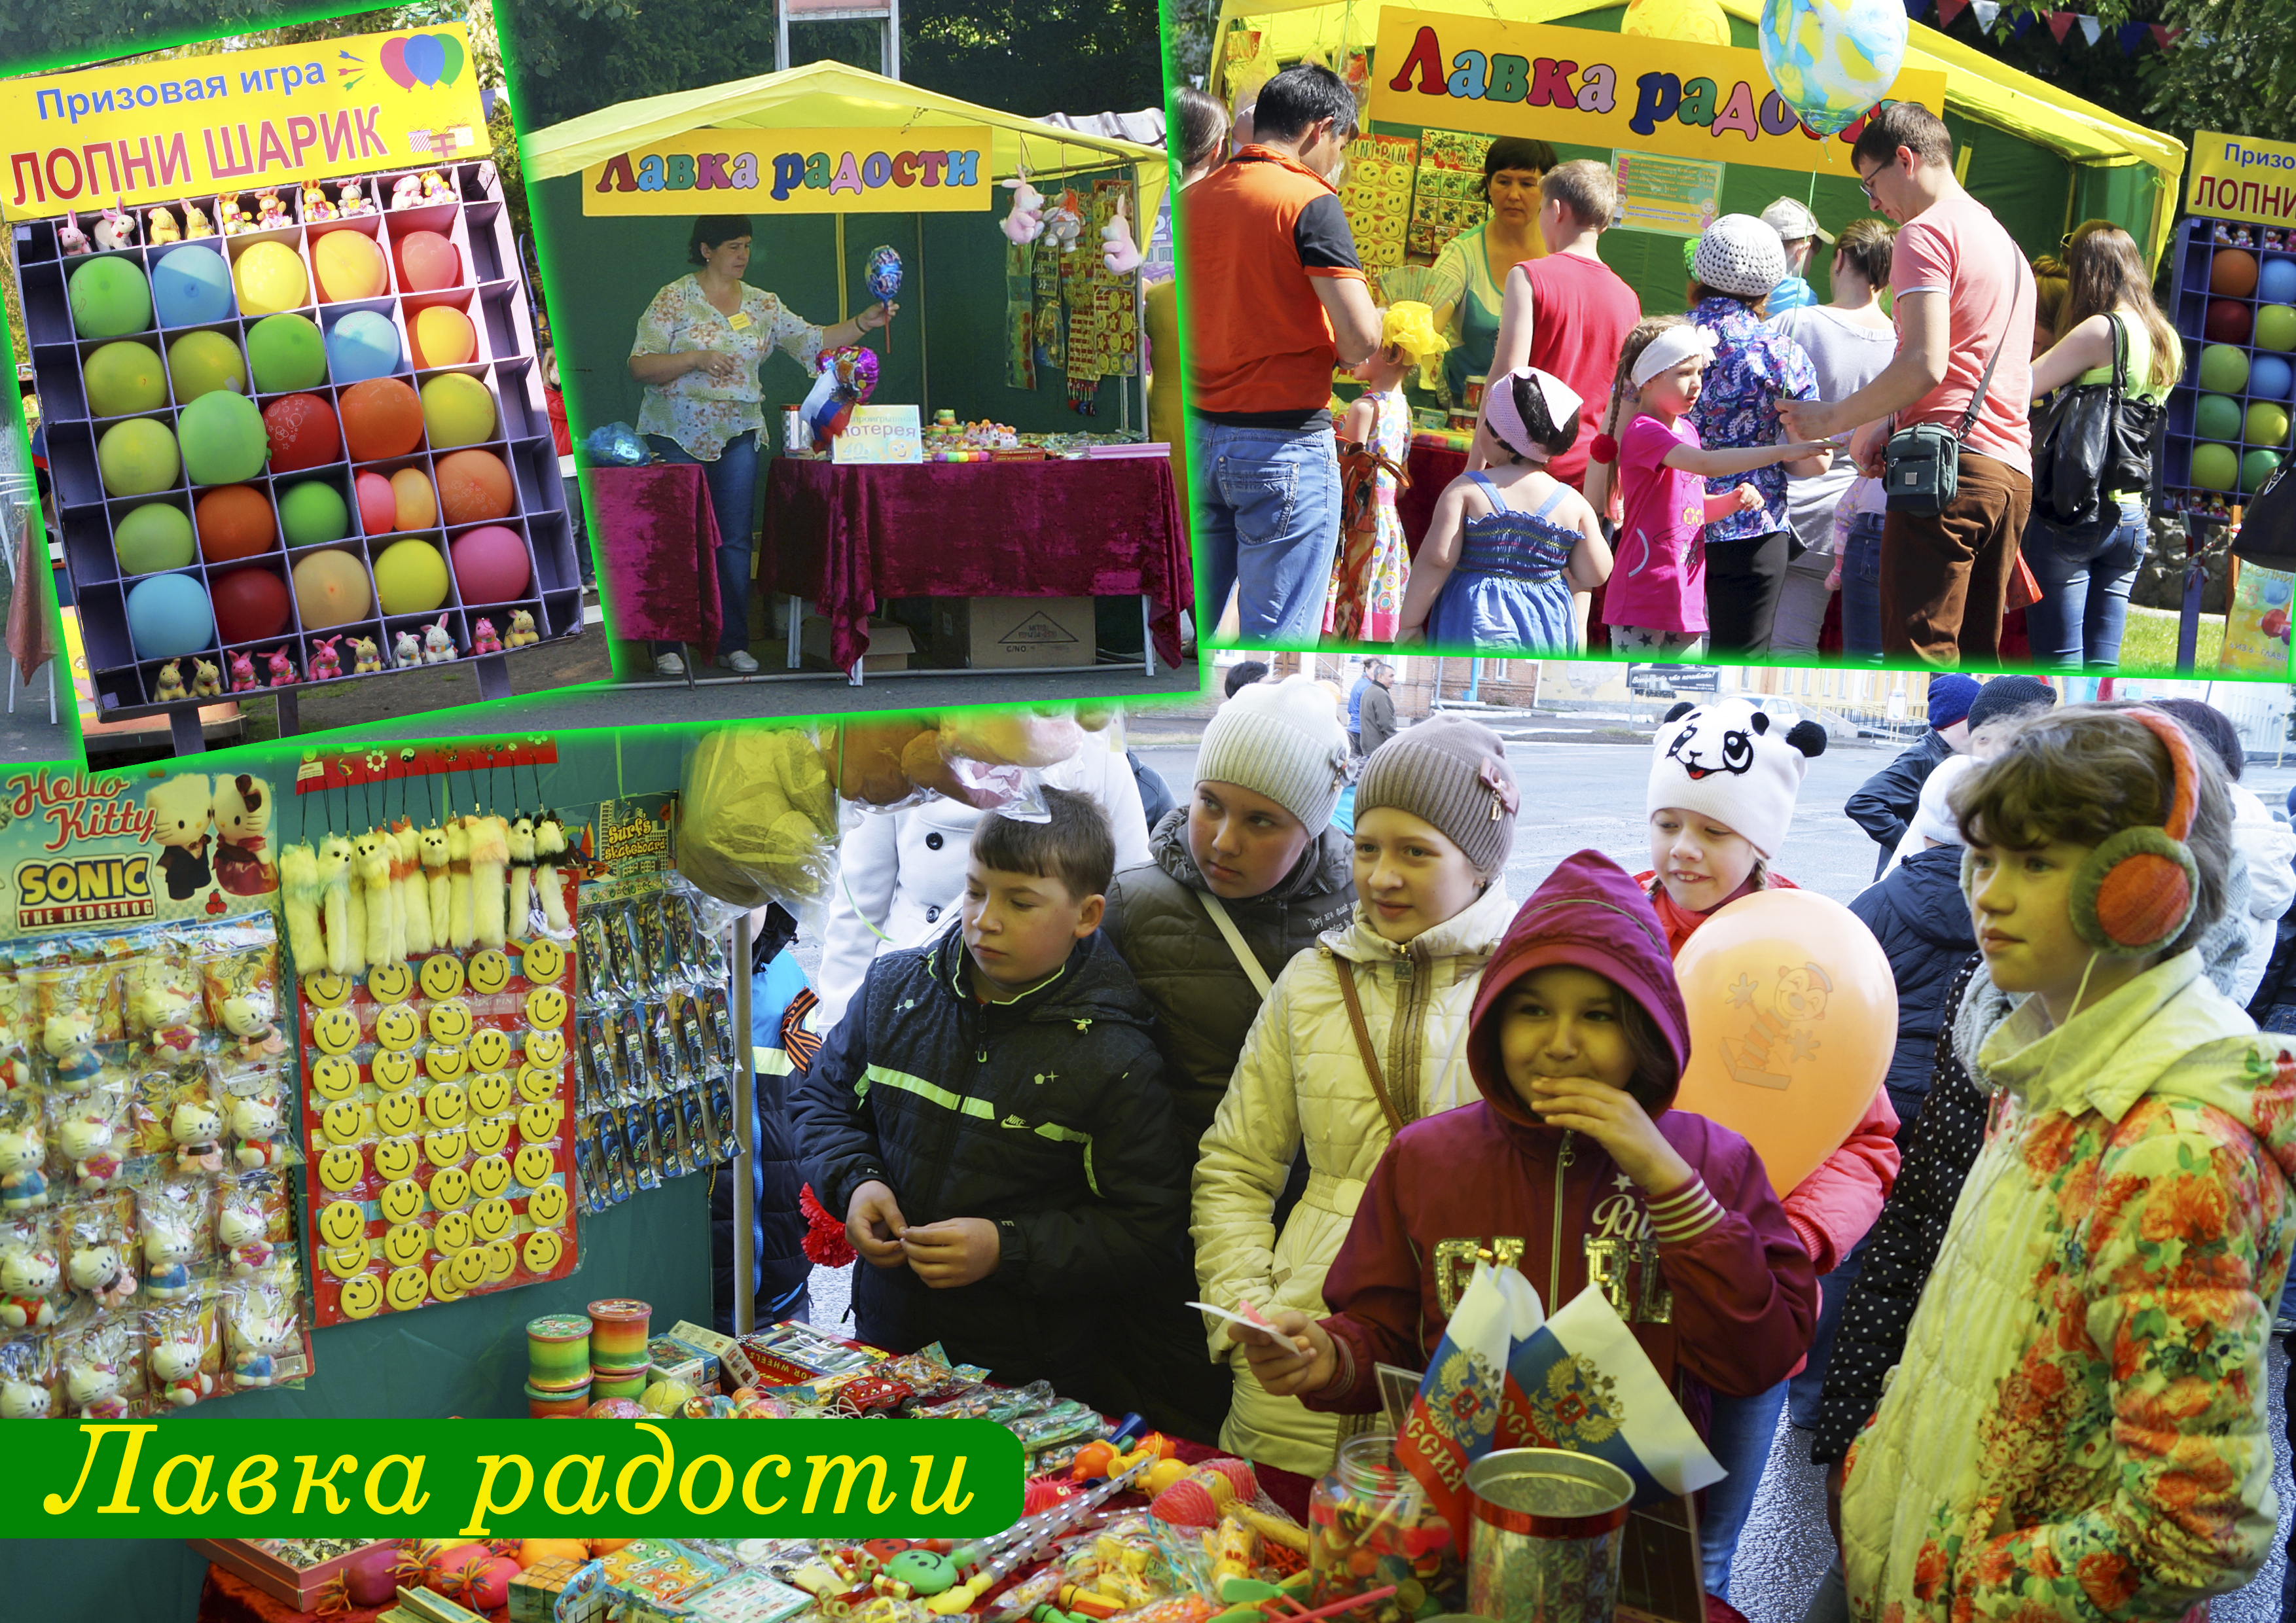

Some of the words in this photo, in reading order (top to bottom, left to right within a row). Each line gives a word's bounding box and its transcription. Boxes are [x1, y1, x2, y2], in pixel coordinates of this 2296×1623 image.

[36, 80, 229, 124] Призовая
[242, 62, 327, 97] игра
[1390, 26, 1616, 113] Лавка
[1629, 71, 1927, 143] радо
[11, 132, 192, 206] ЛОПНИ
[205, 105, 389, 179] ШАРИК
[596, 152, 760, 192] Лавка
[770, 149, 980, 201] радости
[1379, 143, 1408, 164] PIN
[2194, 175, 2296, 221] ЛОПНИ
[8, 768, 131, 815] Hello
[45, 797, 158, 851] Kitty
[608, 812, 652, 844] Surf's
[604, 836, 666, 861] skateboard
[19, 859, 151, 906] SONIC
[21, 910, 54, 926] THE
[495, 997, 513, 1006] PIN
[1006, 1114, 1026, 1126] NIKE
[749, 1351, 790, 1374] WHEELS
